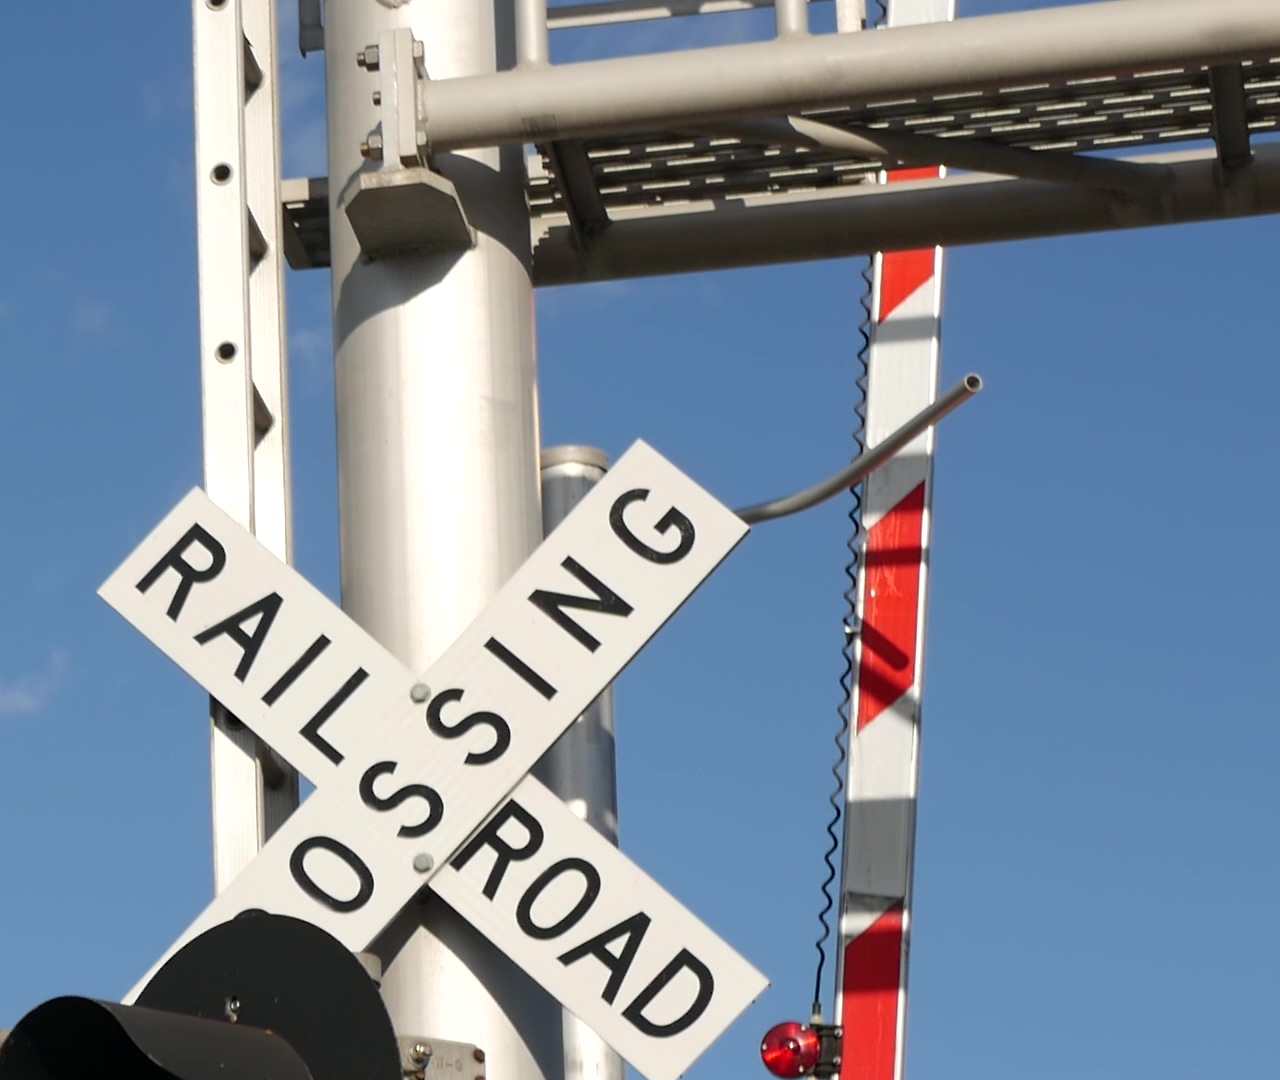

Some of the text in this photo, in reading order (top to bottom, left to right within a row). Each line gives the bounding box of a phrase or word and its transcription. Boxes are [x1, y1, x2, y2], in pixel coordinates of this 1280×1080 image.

[135, 523, 715, 1040] RAIL ROAD
[289, 487, 697, 913] OSSING
